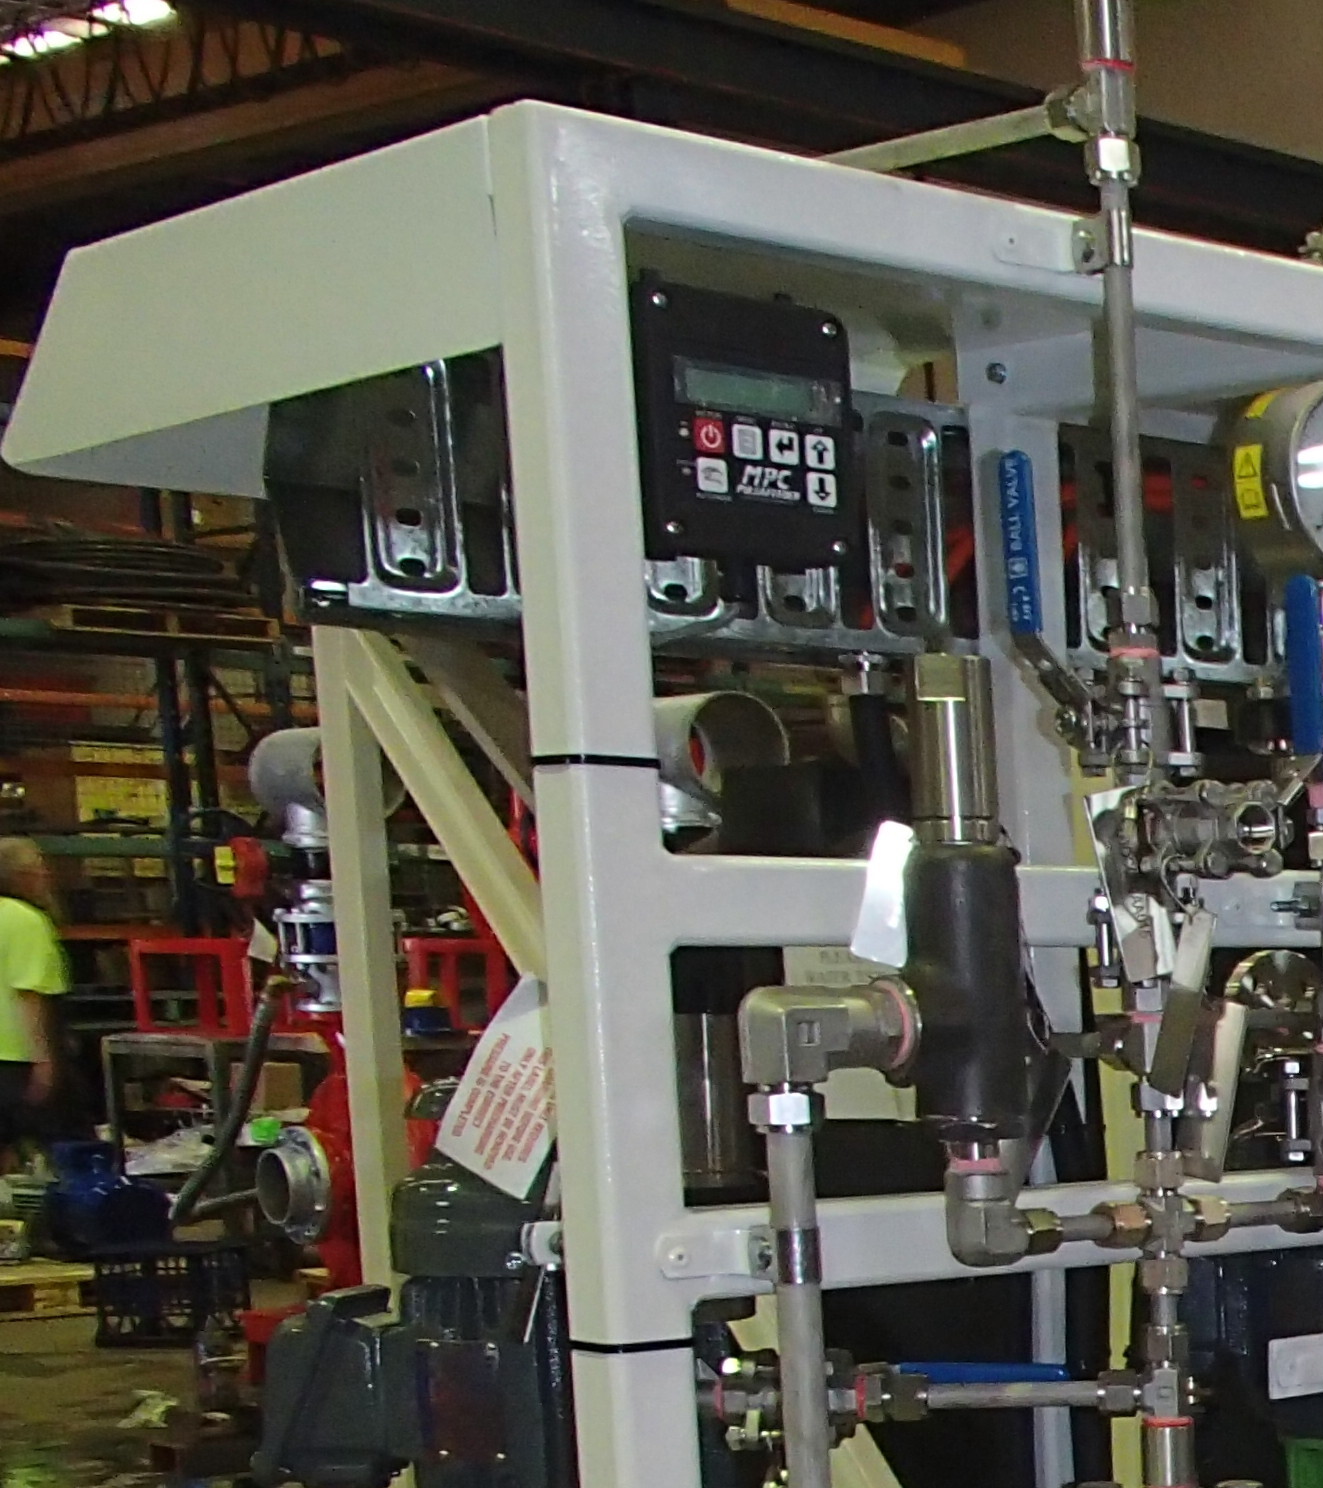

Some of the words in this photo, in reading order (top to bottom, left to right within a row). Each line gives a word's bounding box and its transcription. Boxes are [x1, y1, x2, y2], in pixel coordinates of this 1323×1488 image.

[742, 464, 792, 490] MPC
[1004, 458, 1020, 509] VALVE
[1008, 516, 1022, 551] BALL
